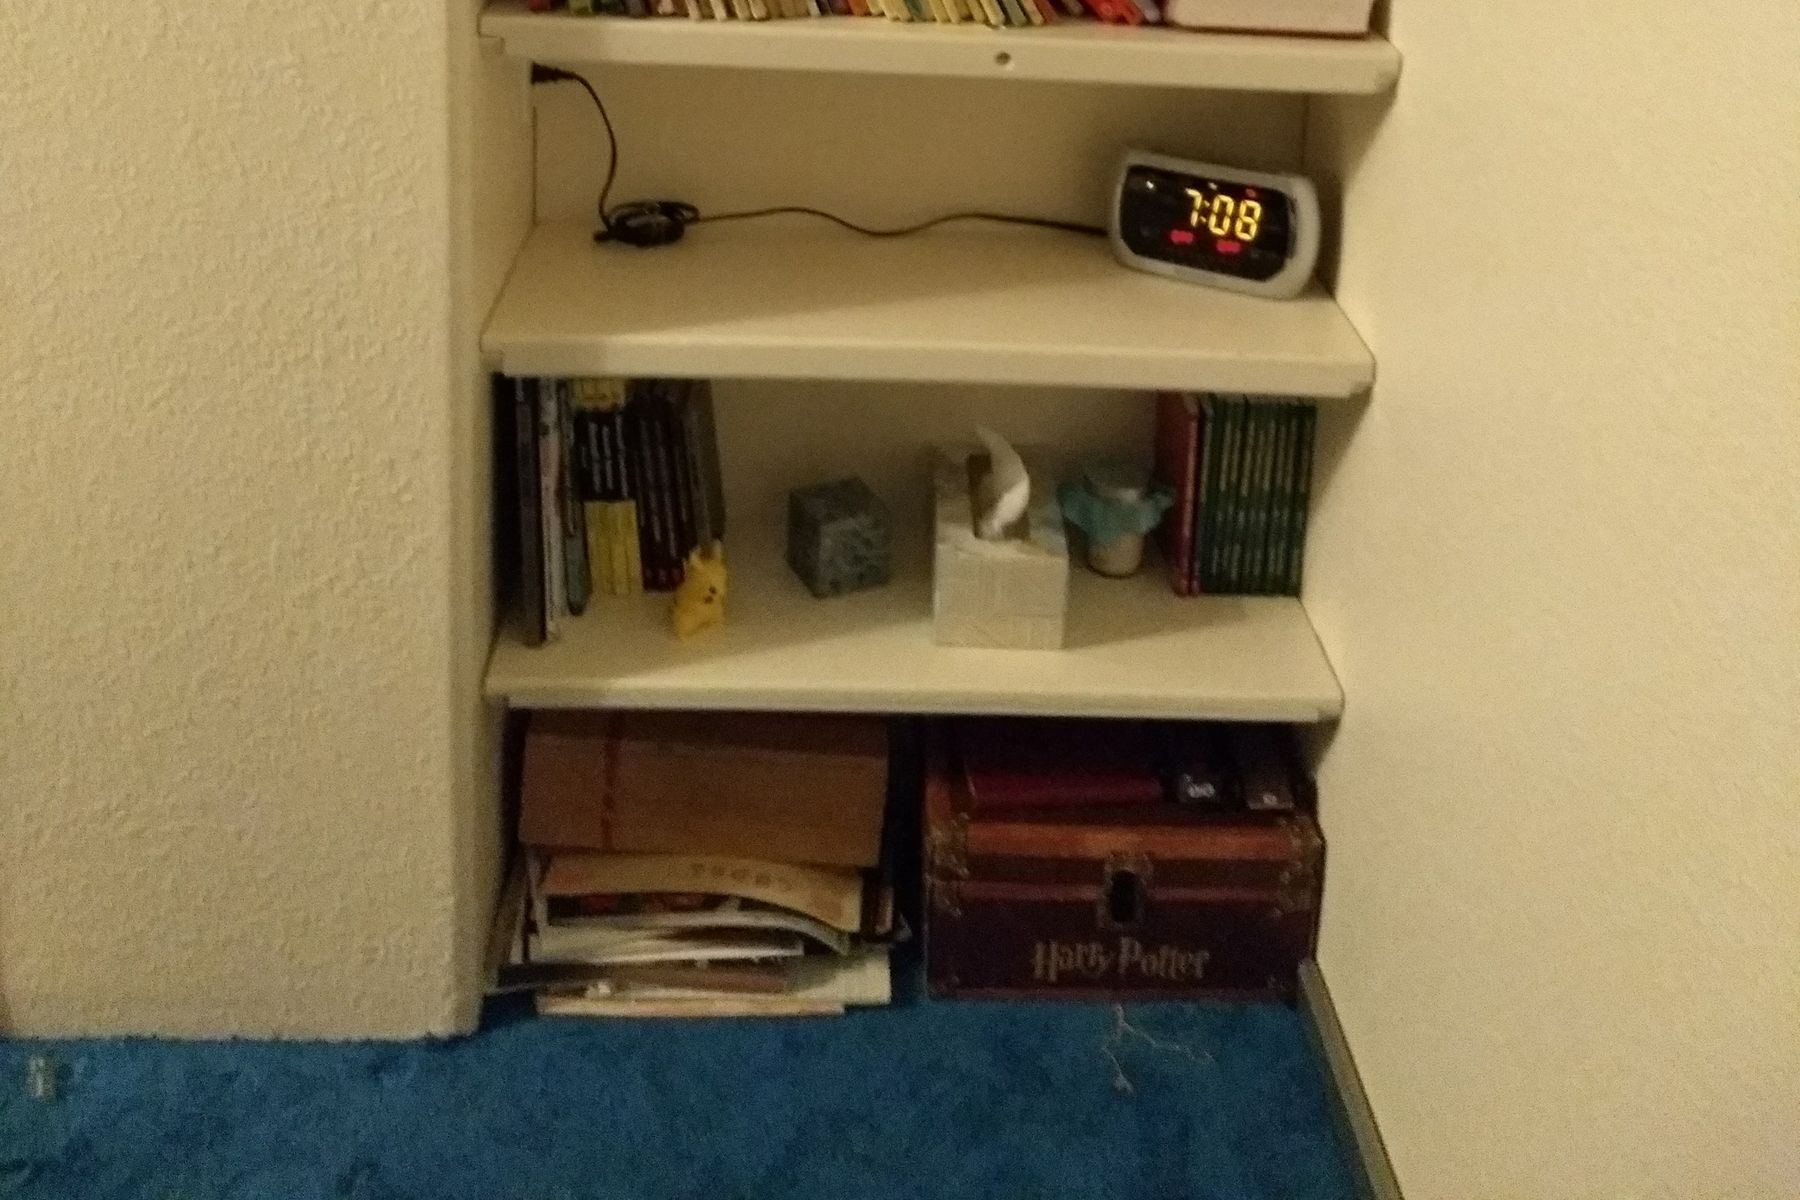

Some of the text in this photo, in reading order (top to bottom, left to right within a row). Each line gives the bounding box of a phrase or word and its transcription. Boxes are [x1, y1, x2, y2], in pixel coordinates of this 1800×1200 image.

[1185, 188, 1262, 241] 7:08
[1031, 936, 1210, 983] Harry Potter
